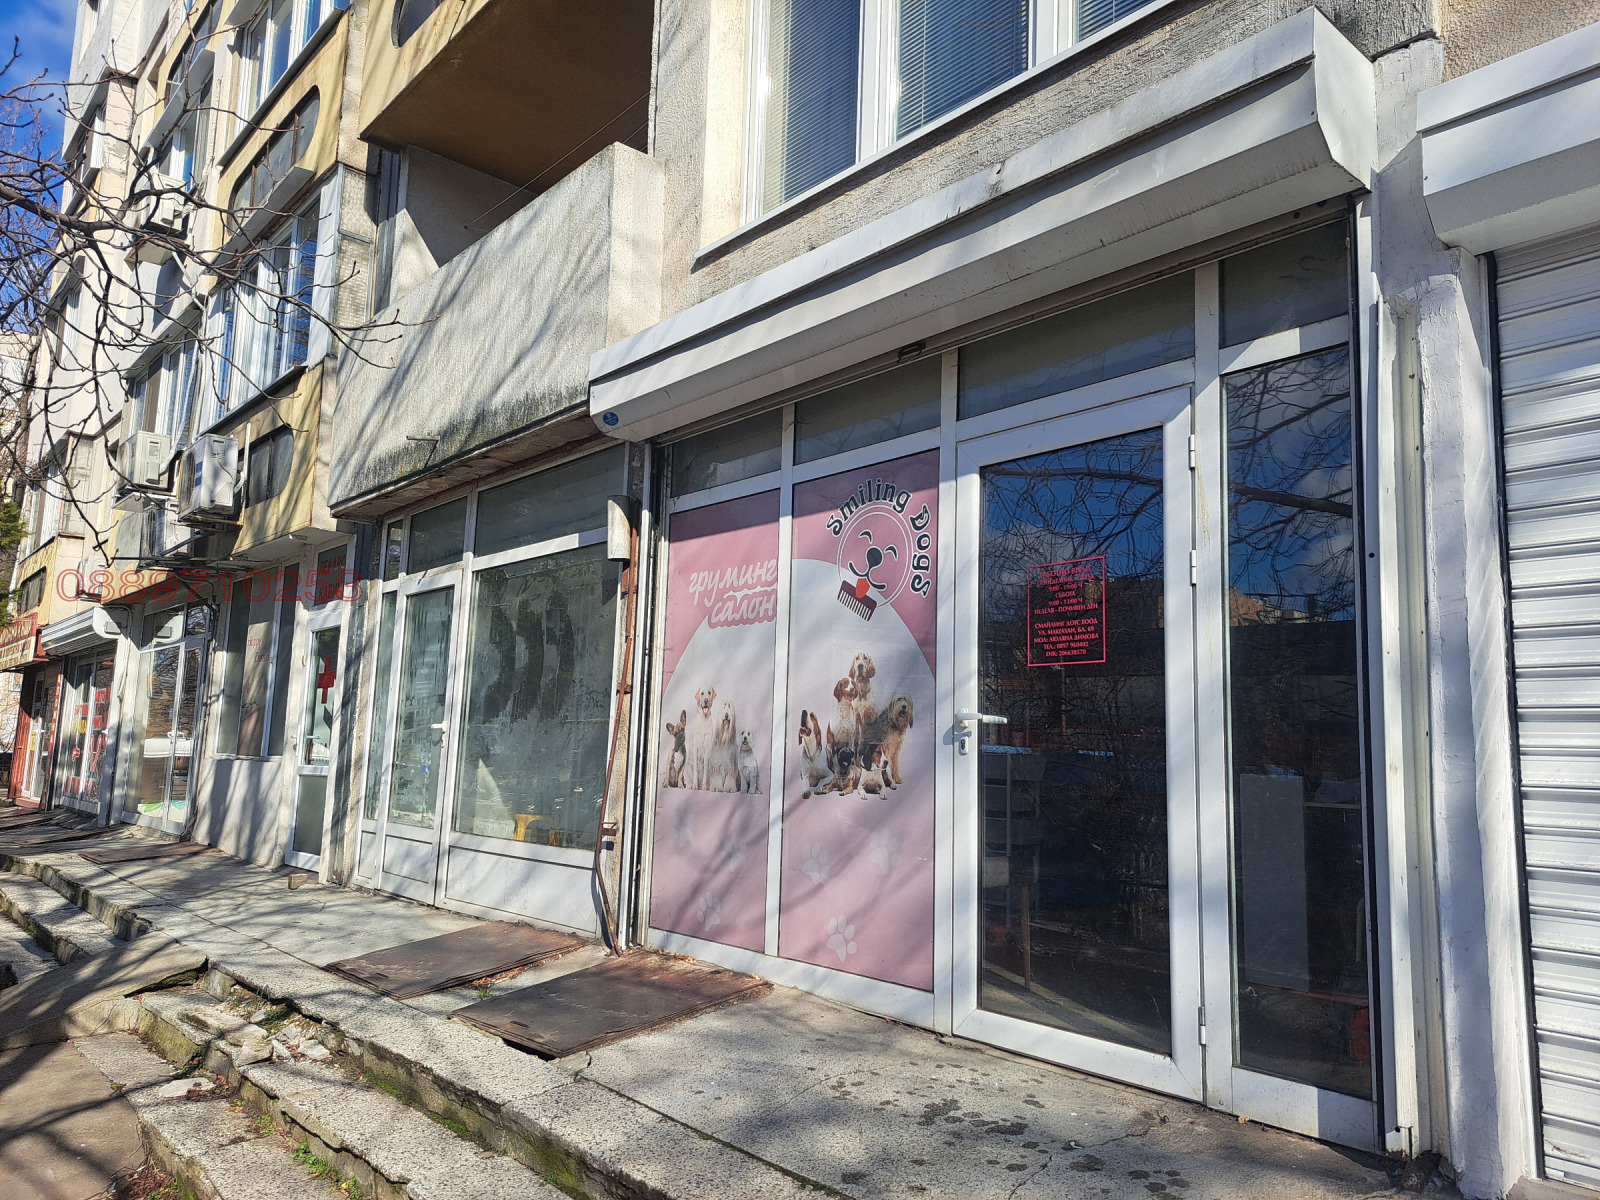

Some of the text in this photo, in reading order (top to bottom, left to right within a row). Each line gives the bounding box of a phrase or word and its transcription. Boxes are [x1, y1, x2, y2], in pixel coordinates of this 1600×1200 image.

[826, 478, 932, 598] Smiling Dogs
[688, 558, 777, 607] груминг
[711, 594, 776, 624] салон
